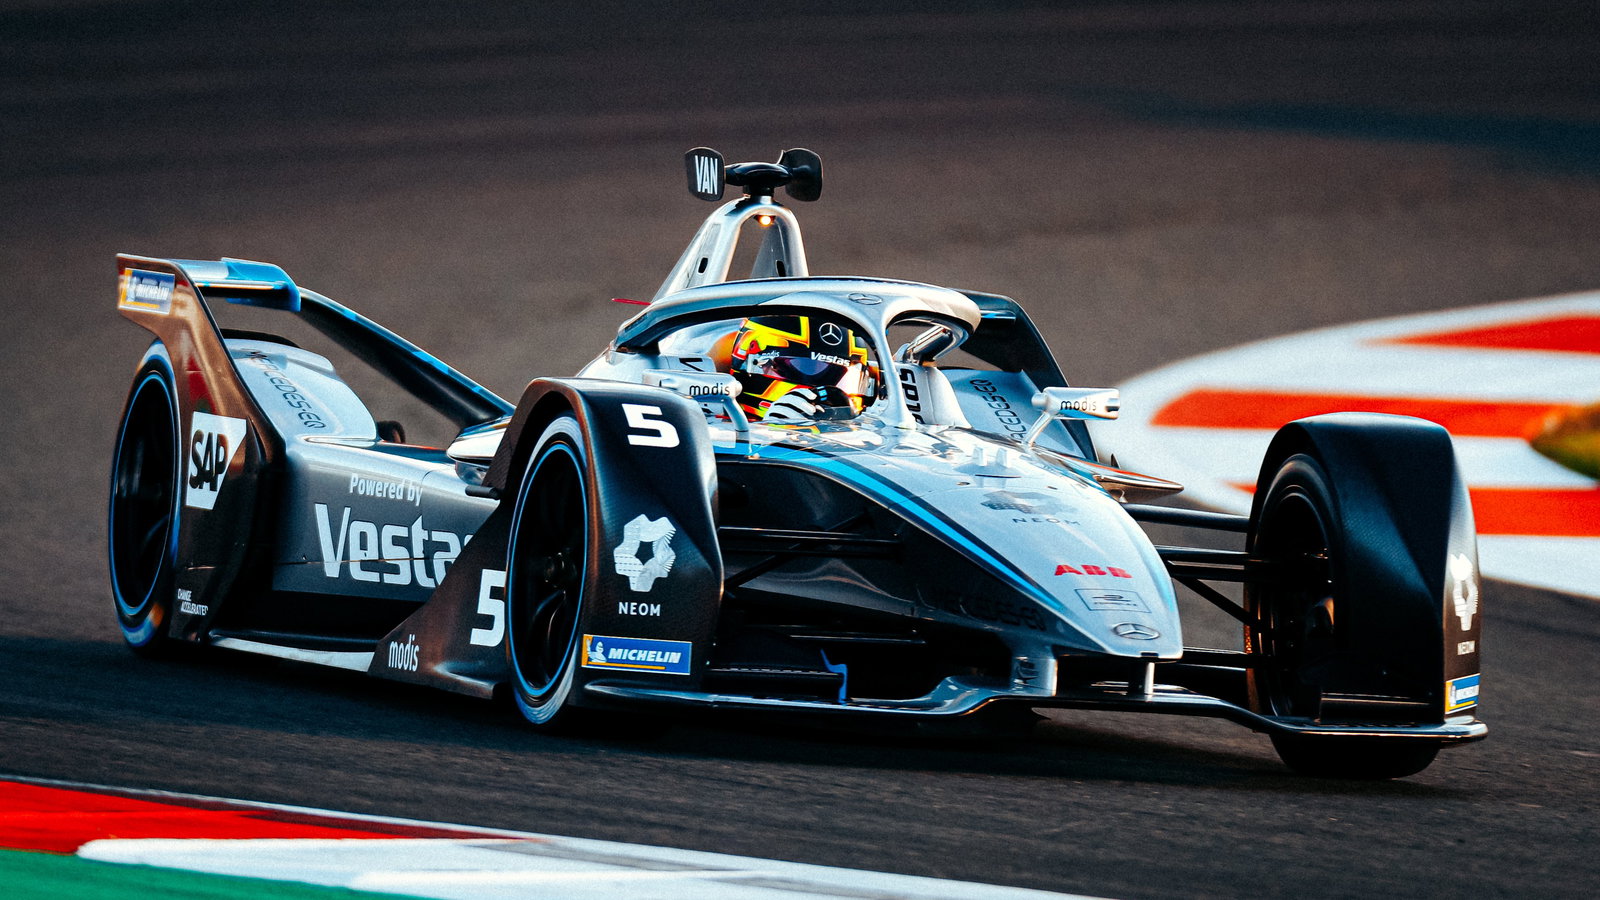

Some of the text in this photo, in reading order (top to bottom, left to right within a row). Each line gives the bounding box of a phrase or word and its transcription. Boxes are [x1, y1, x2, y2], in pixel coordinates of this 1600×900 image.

[694, 154, 718, 195] VAN
[810, 351, 851, 367] Vestas
[689, 383, 730, 396] modis
[1060, 397, 1097, 411] modis
[621, 403, 680, 448] 5
[189, 429, 229, 492] SAP
[350, 472, 424, 507] Powered by
[1012, 517, 1081, 526] NEOM
[314, 503, 474, 588] Vesta
[1054, 564, 1133, 579] ABB
[469, 568, 507, 647] 5
[618, 601, 661, 617] NEOM
[388, 633, 420, 672] modis
[607, 646, 682, 664] MICHELIN
